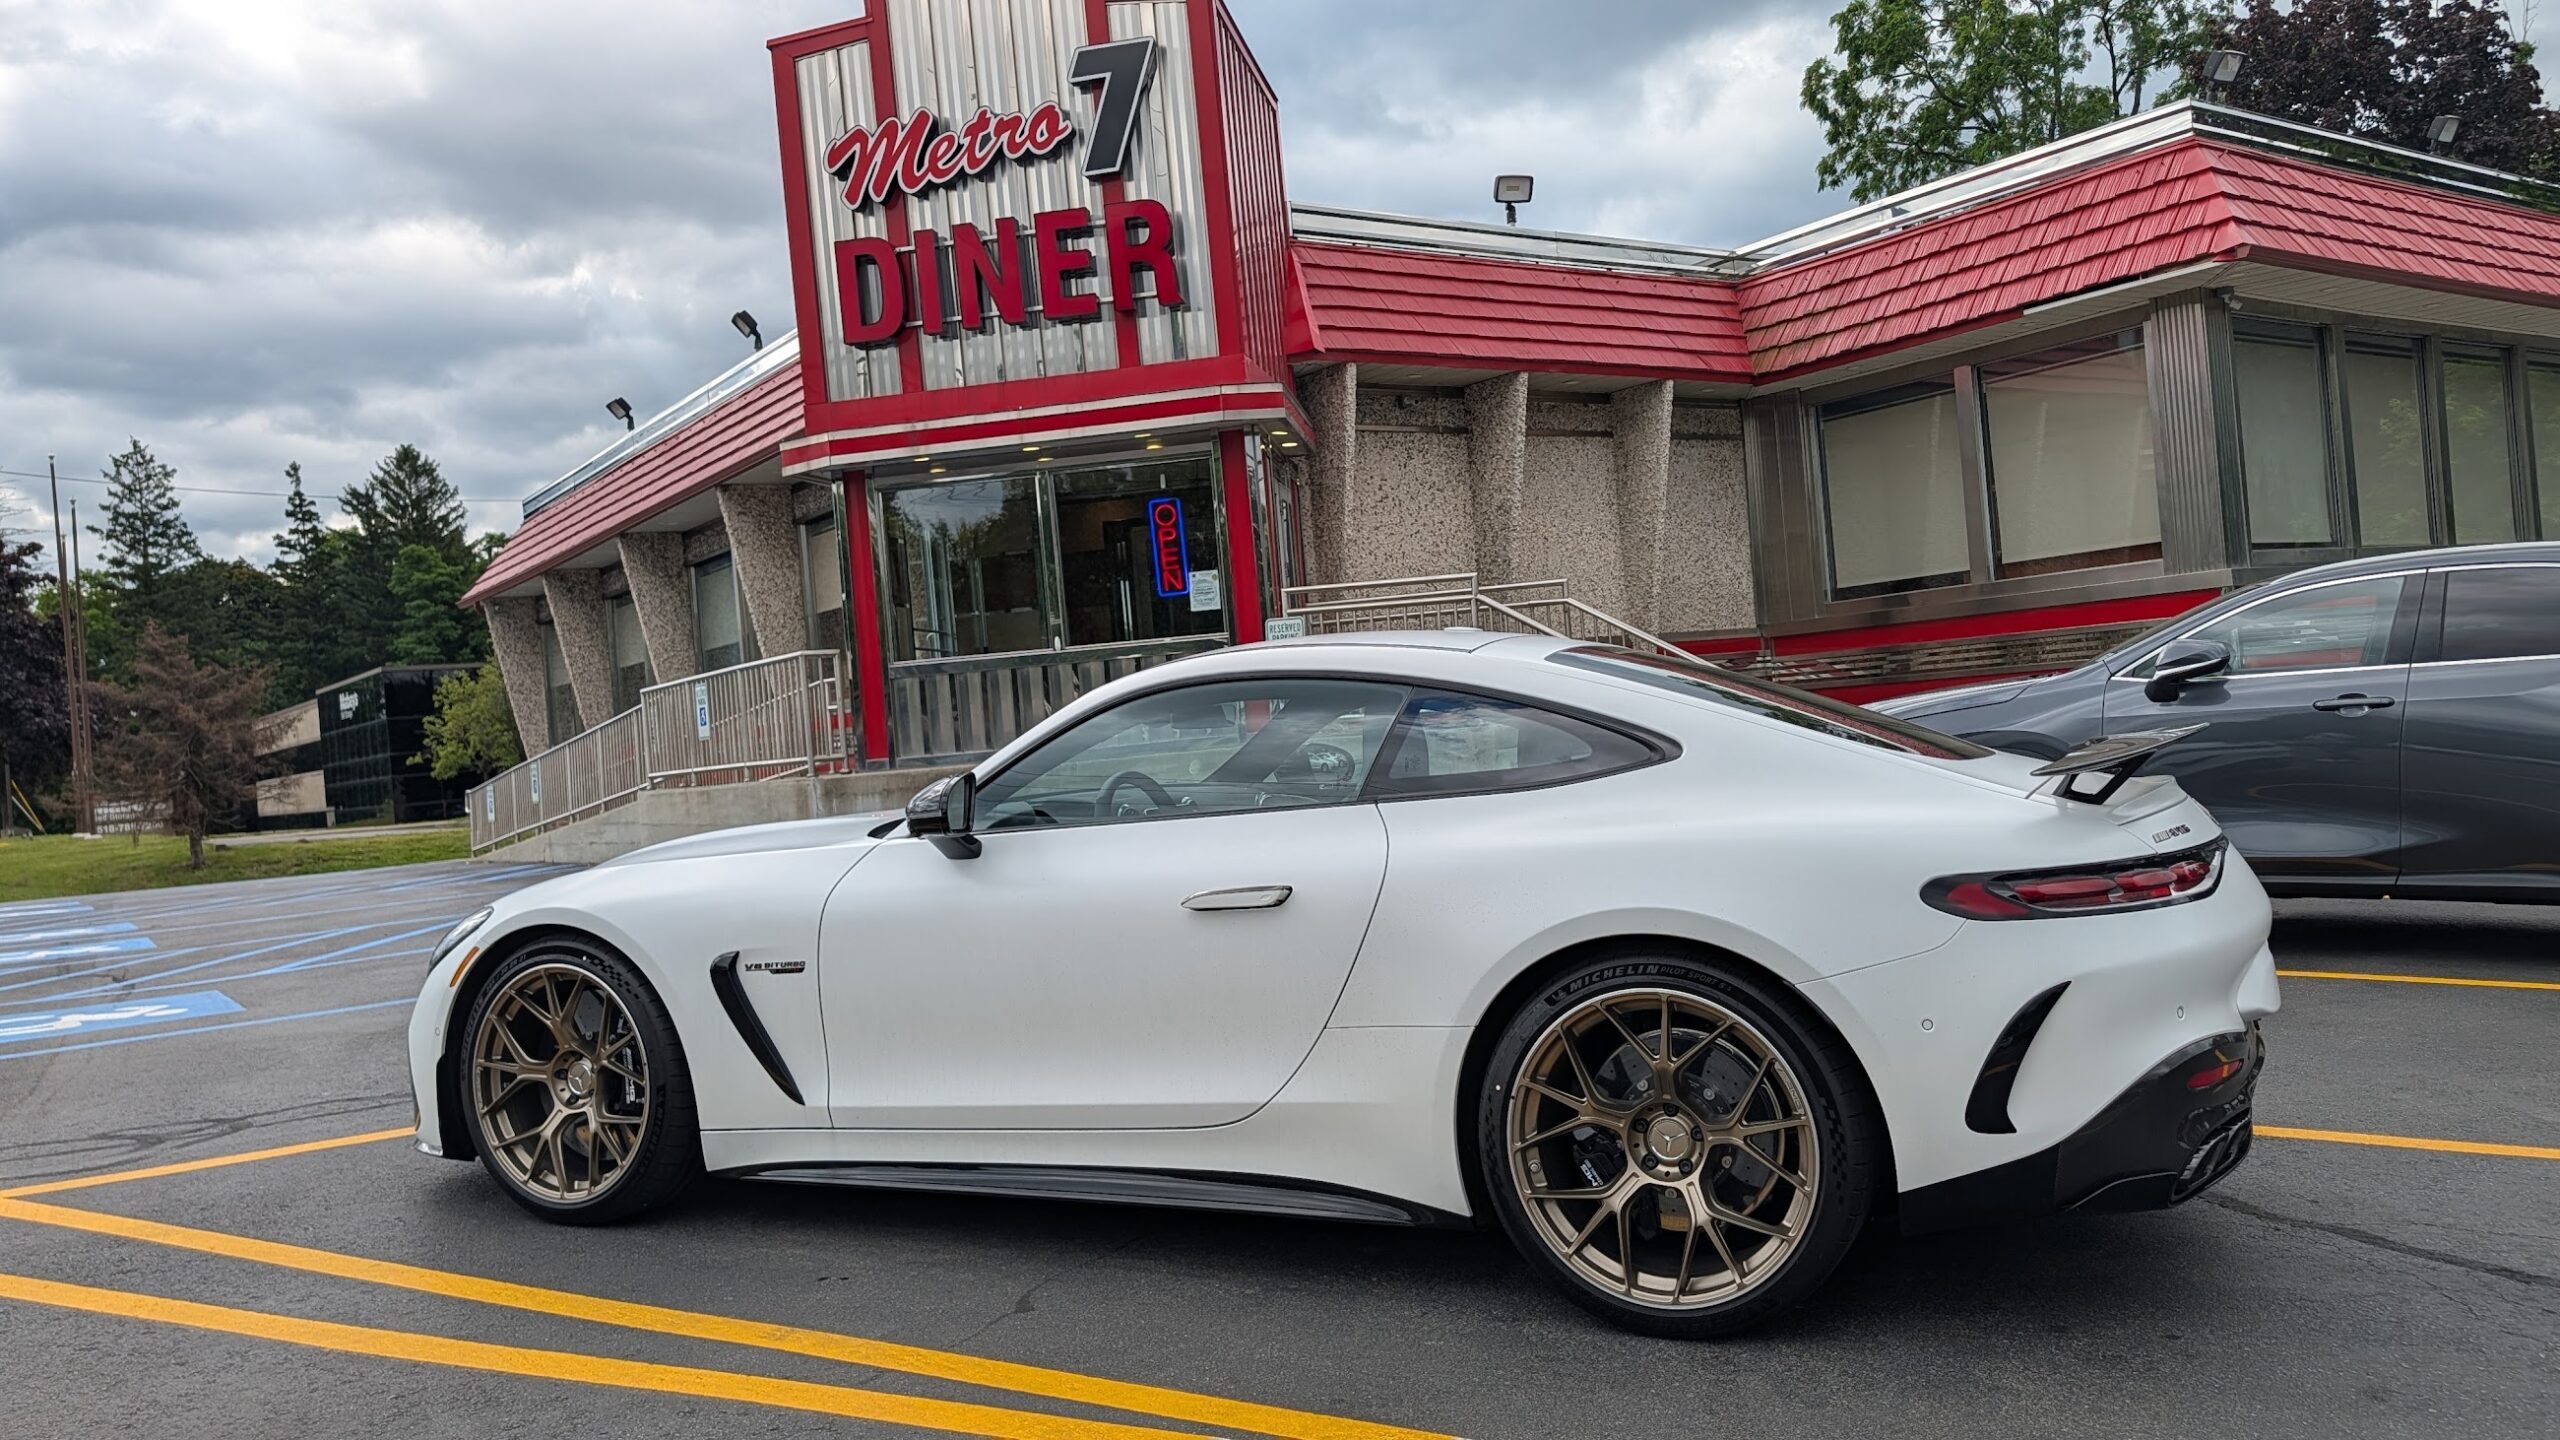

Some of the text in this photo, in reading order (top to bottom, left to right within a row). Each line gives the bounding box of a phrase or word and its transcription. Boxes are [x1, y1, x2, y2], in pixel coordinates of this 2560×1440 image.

[824, 36, 1157, 210] Metro 7
[834, 199, 1183, 346] DINER
[1155, 504, 1183, 591] OPEN
[1269, 623, 1301, 633] RESERVED
[764, 961, 806, 969] BITURBO
[1569, 965, 1660, 992] MICHELIN
[1660, 967, 1687, 976] PILOT
[1688, 972, 1717, 985] SPORT
